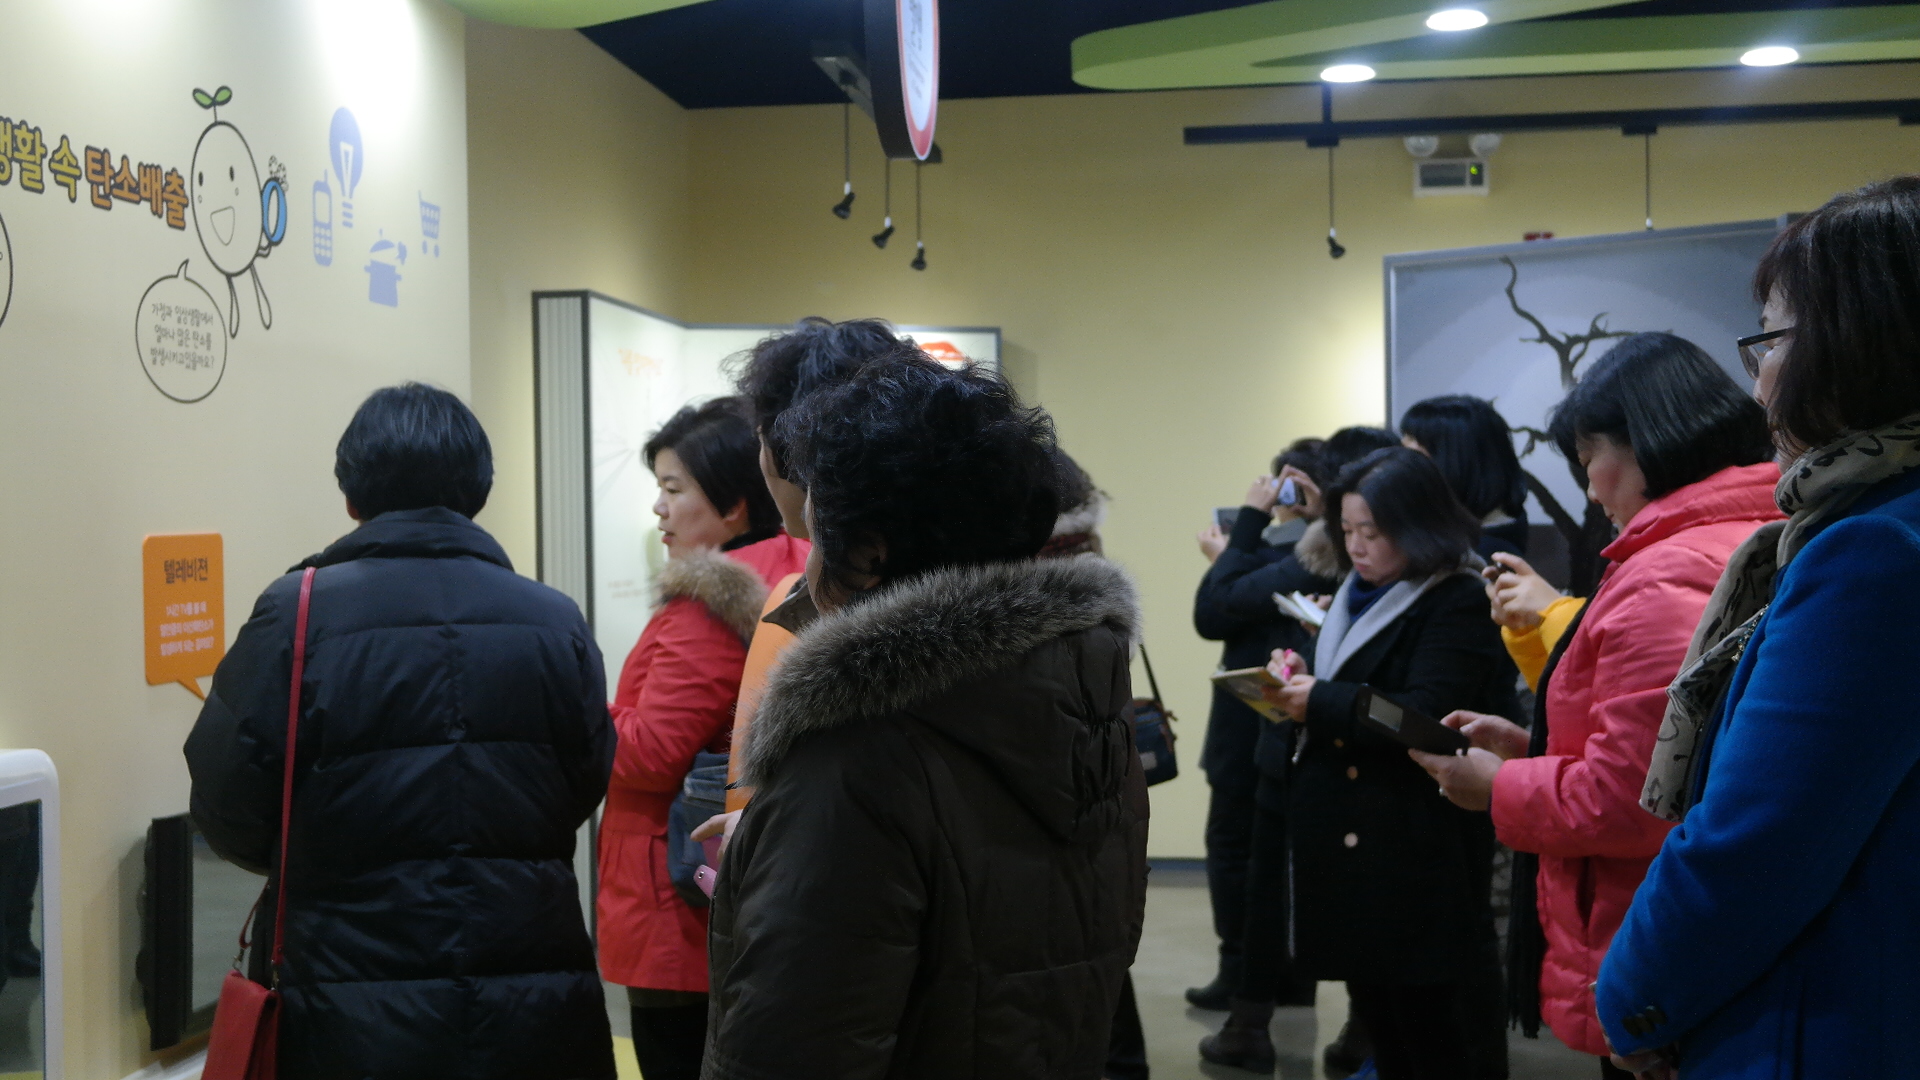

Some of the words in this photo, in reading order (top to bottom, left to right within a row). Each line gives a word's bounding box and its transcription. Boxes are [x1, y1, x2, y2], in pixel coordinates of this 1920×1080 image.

[49, 134, 82, 203] 속
[85, 145, 189, 230] 탄소배출
[152, 303, 172, 321] 가정과
[174, 305, 213, 327] 일상생활에서
[154, 324, 175, 343] 얼마나
[177, 328, 190, 347] 많은
[192, 331, 212, 351] 탄소를
